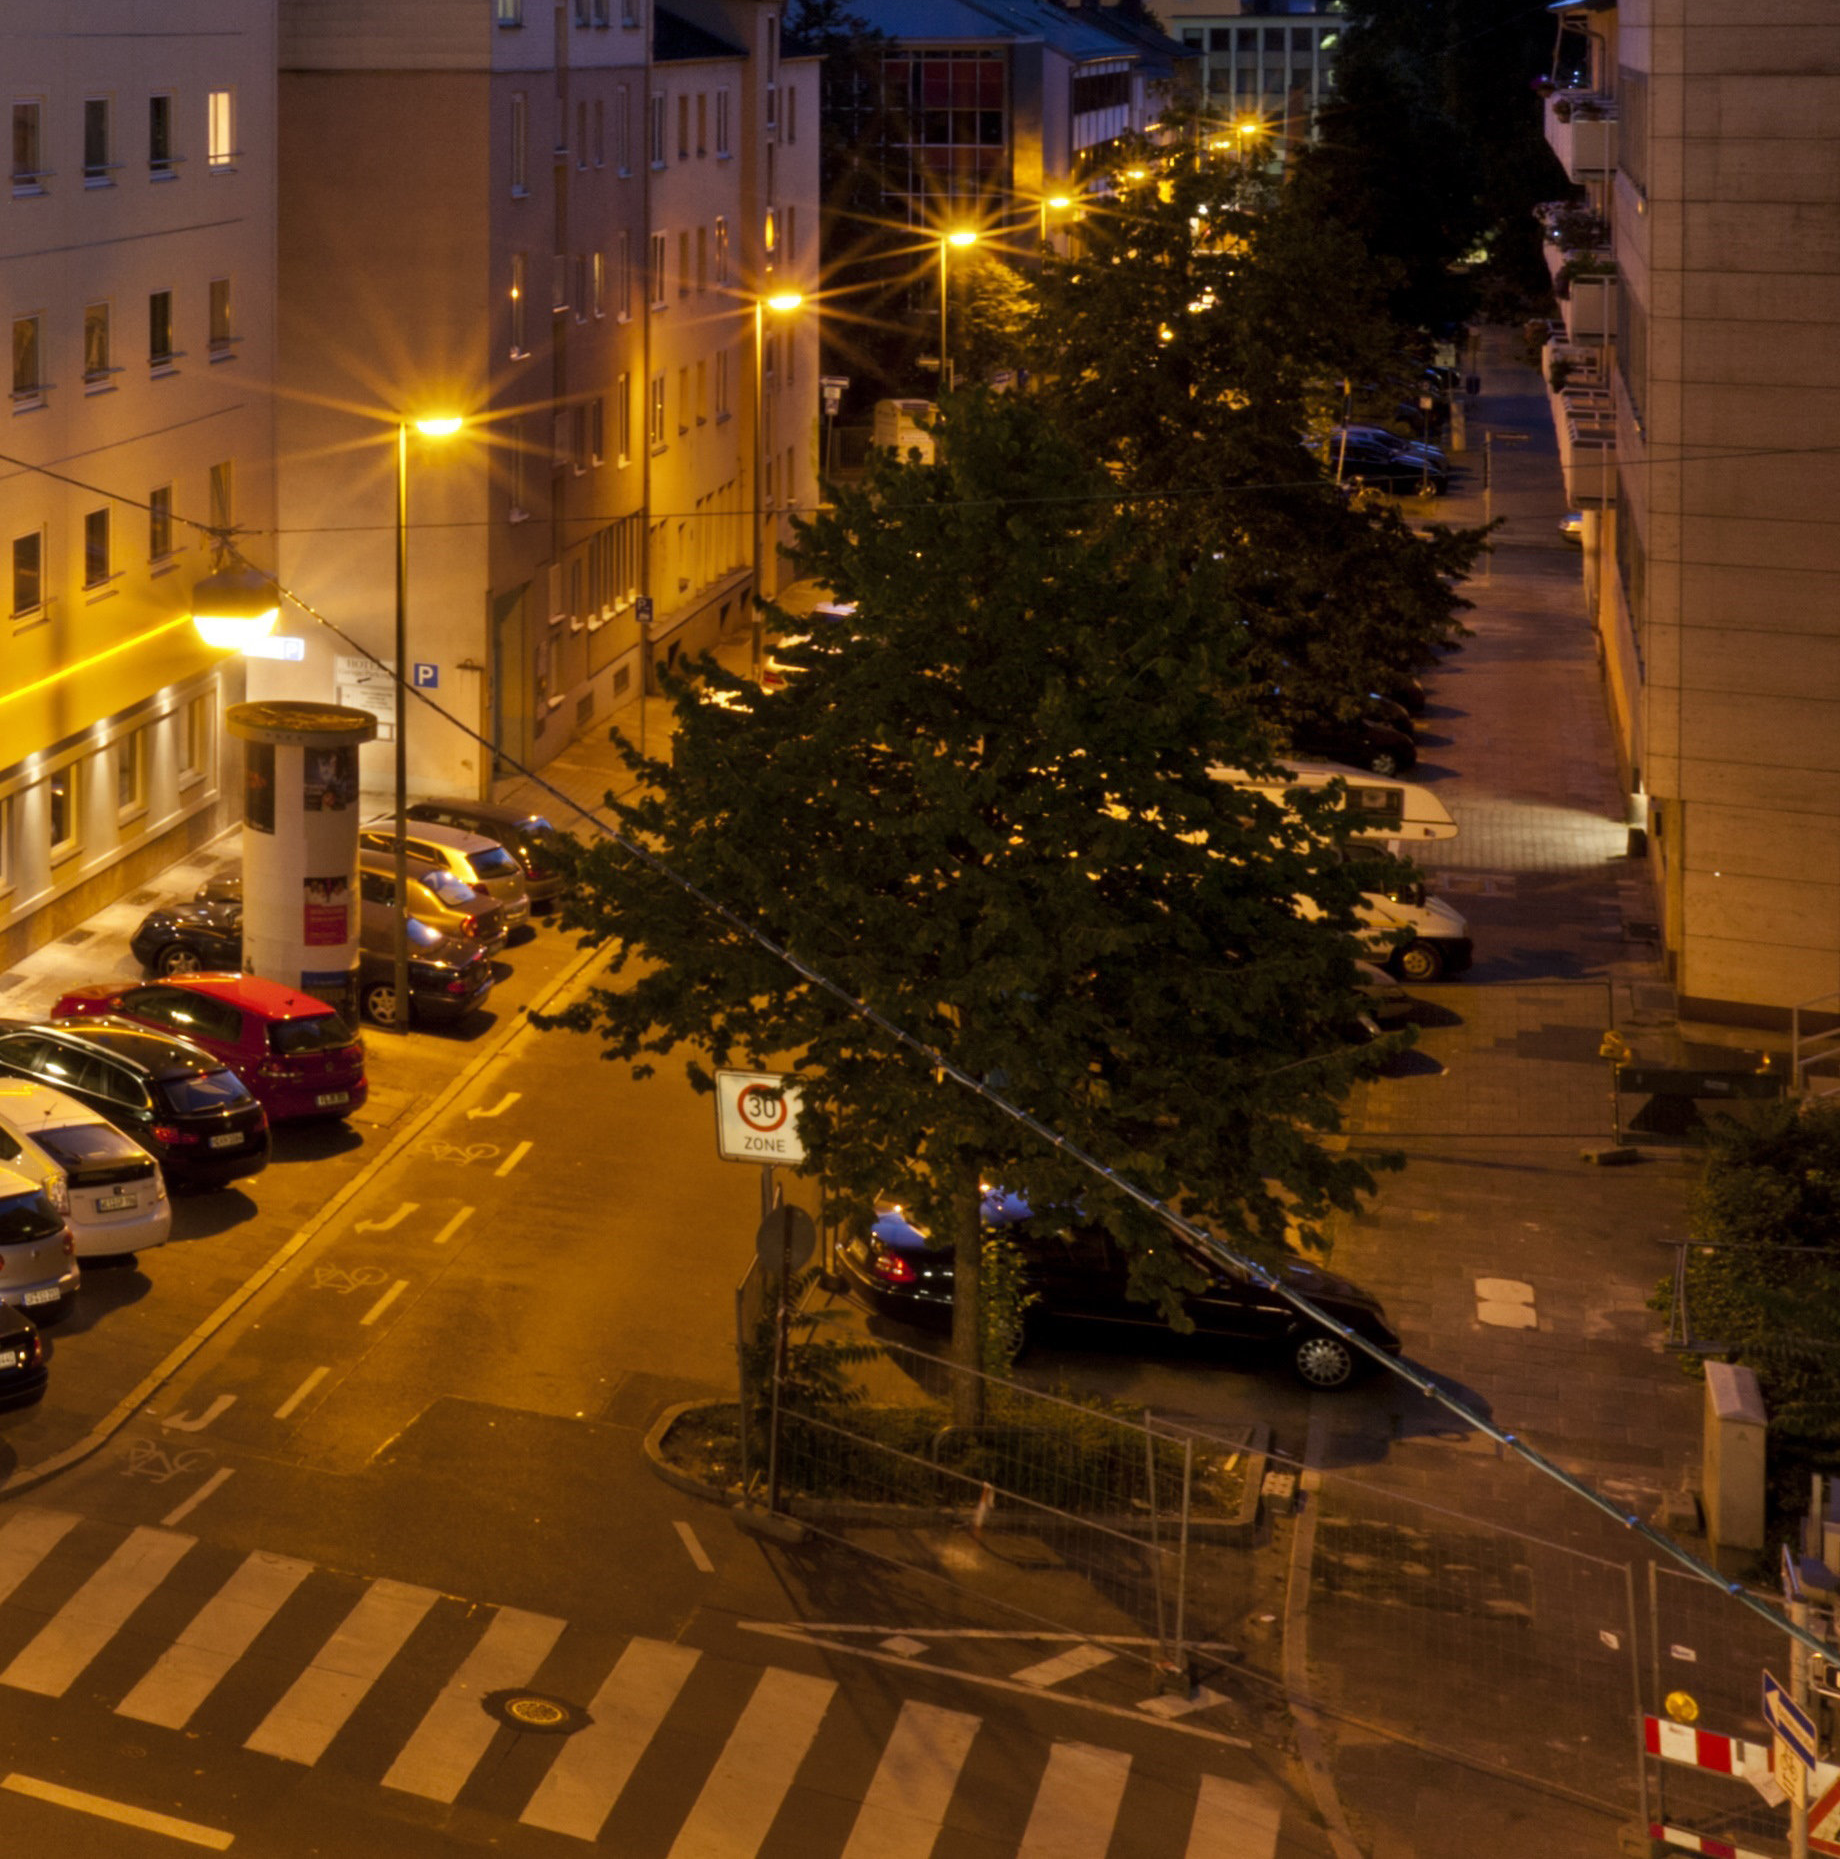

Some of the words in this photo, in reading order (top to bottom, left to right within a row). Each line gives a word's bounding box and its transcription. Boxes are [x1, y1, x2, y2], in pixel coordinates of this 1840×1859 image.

[418, 665, 435, 686] P
[748, 1096, 777, 1119] 30
[744, 1135, 787, 1153] ZONE
